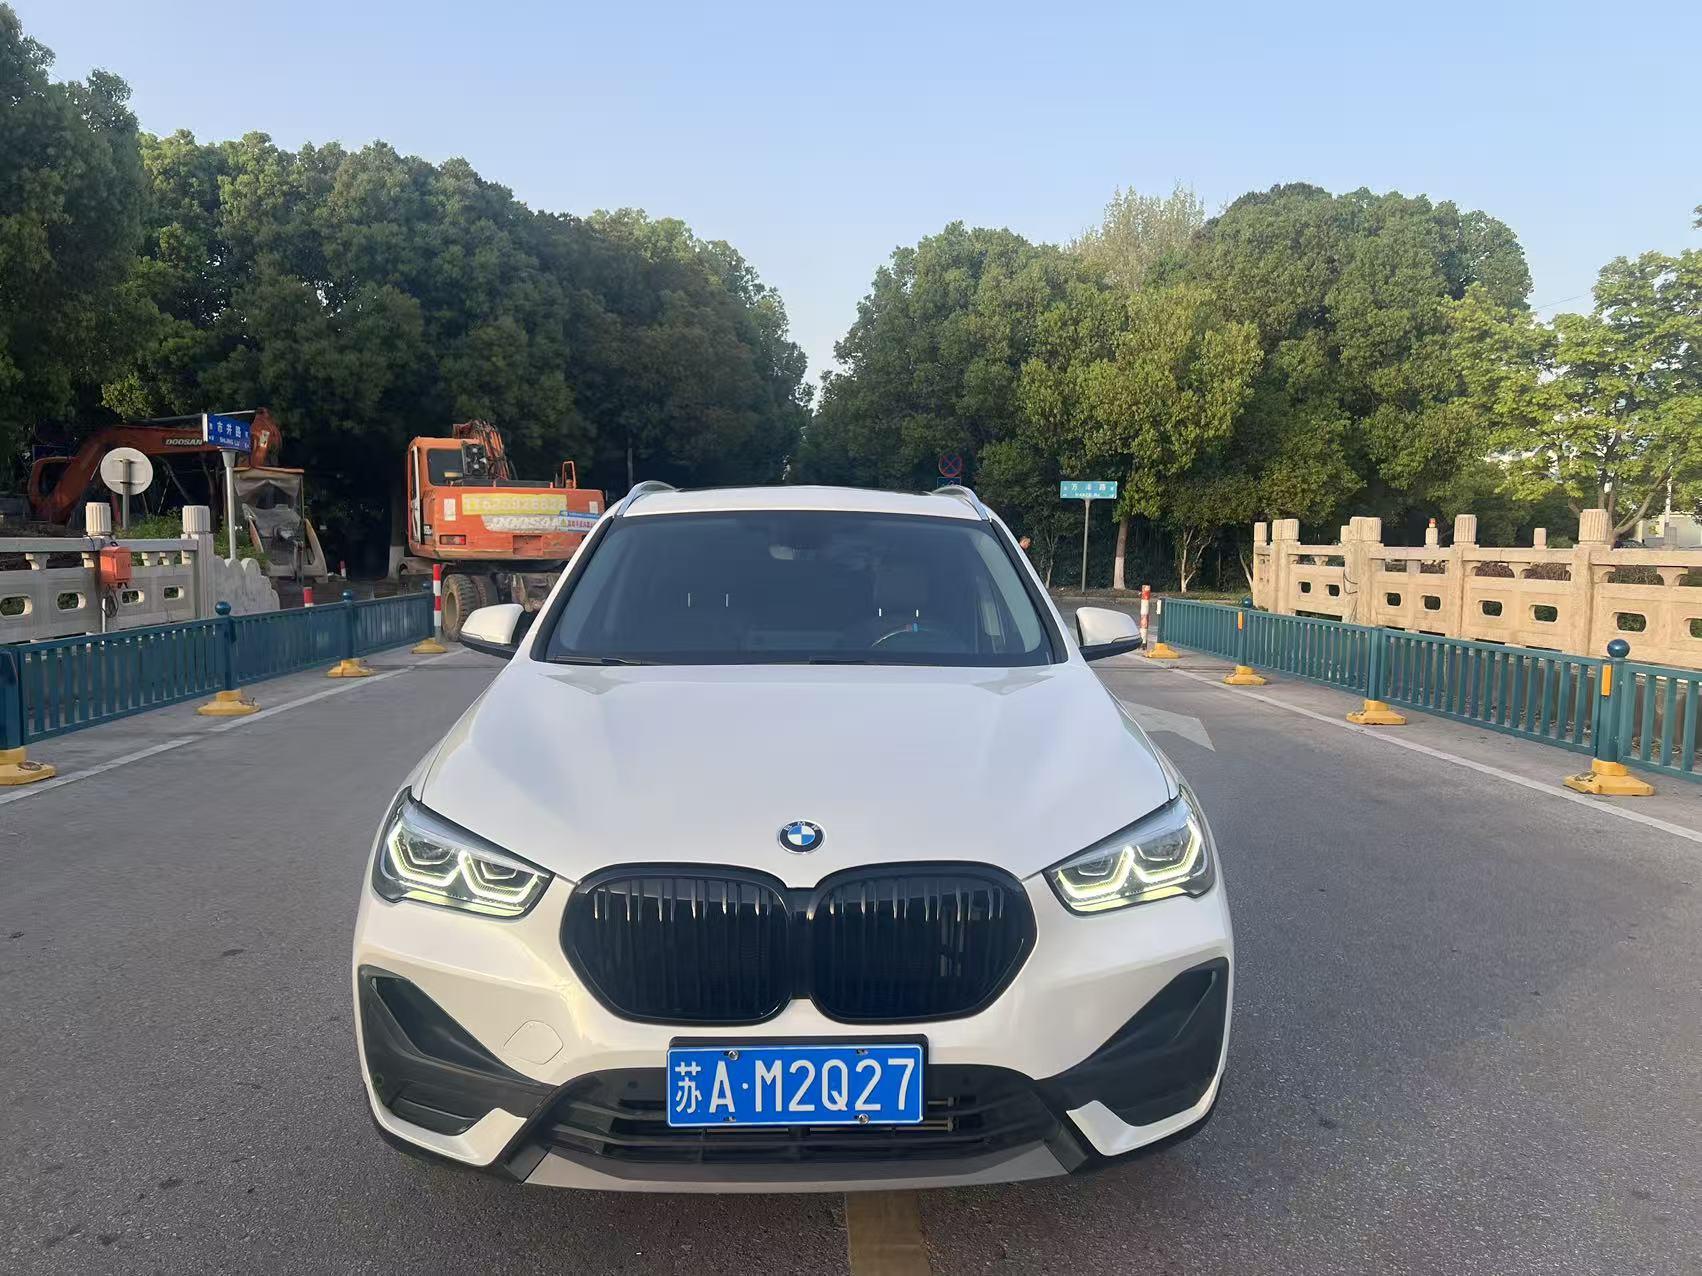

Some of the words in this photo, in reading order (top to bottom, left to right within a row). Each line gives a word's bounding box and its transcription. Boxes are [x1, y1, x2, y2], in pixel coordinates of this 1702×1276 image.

[165, 438, 203, 446] DOOSAN
[783, 820, 821, 831] BMW
[674, 1057, 916, 1114] 苏A·M2Q27
